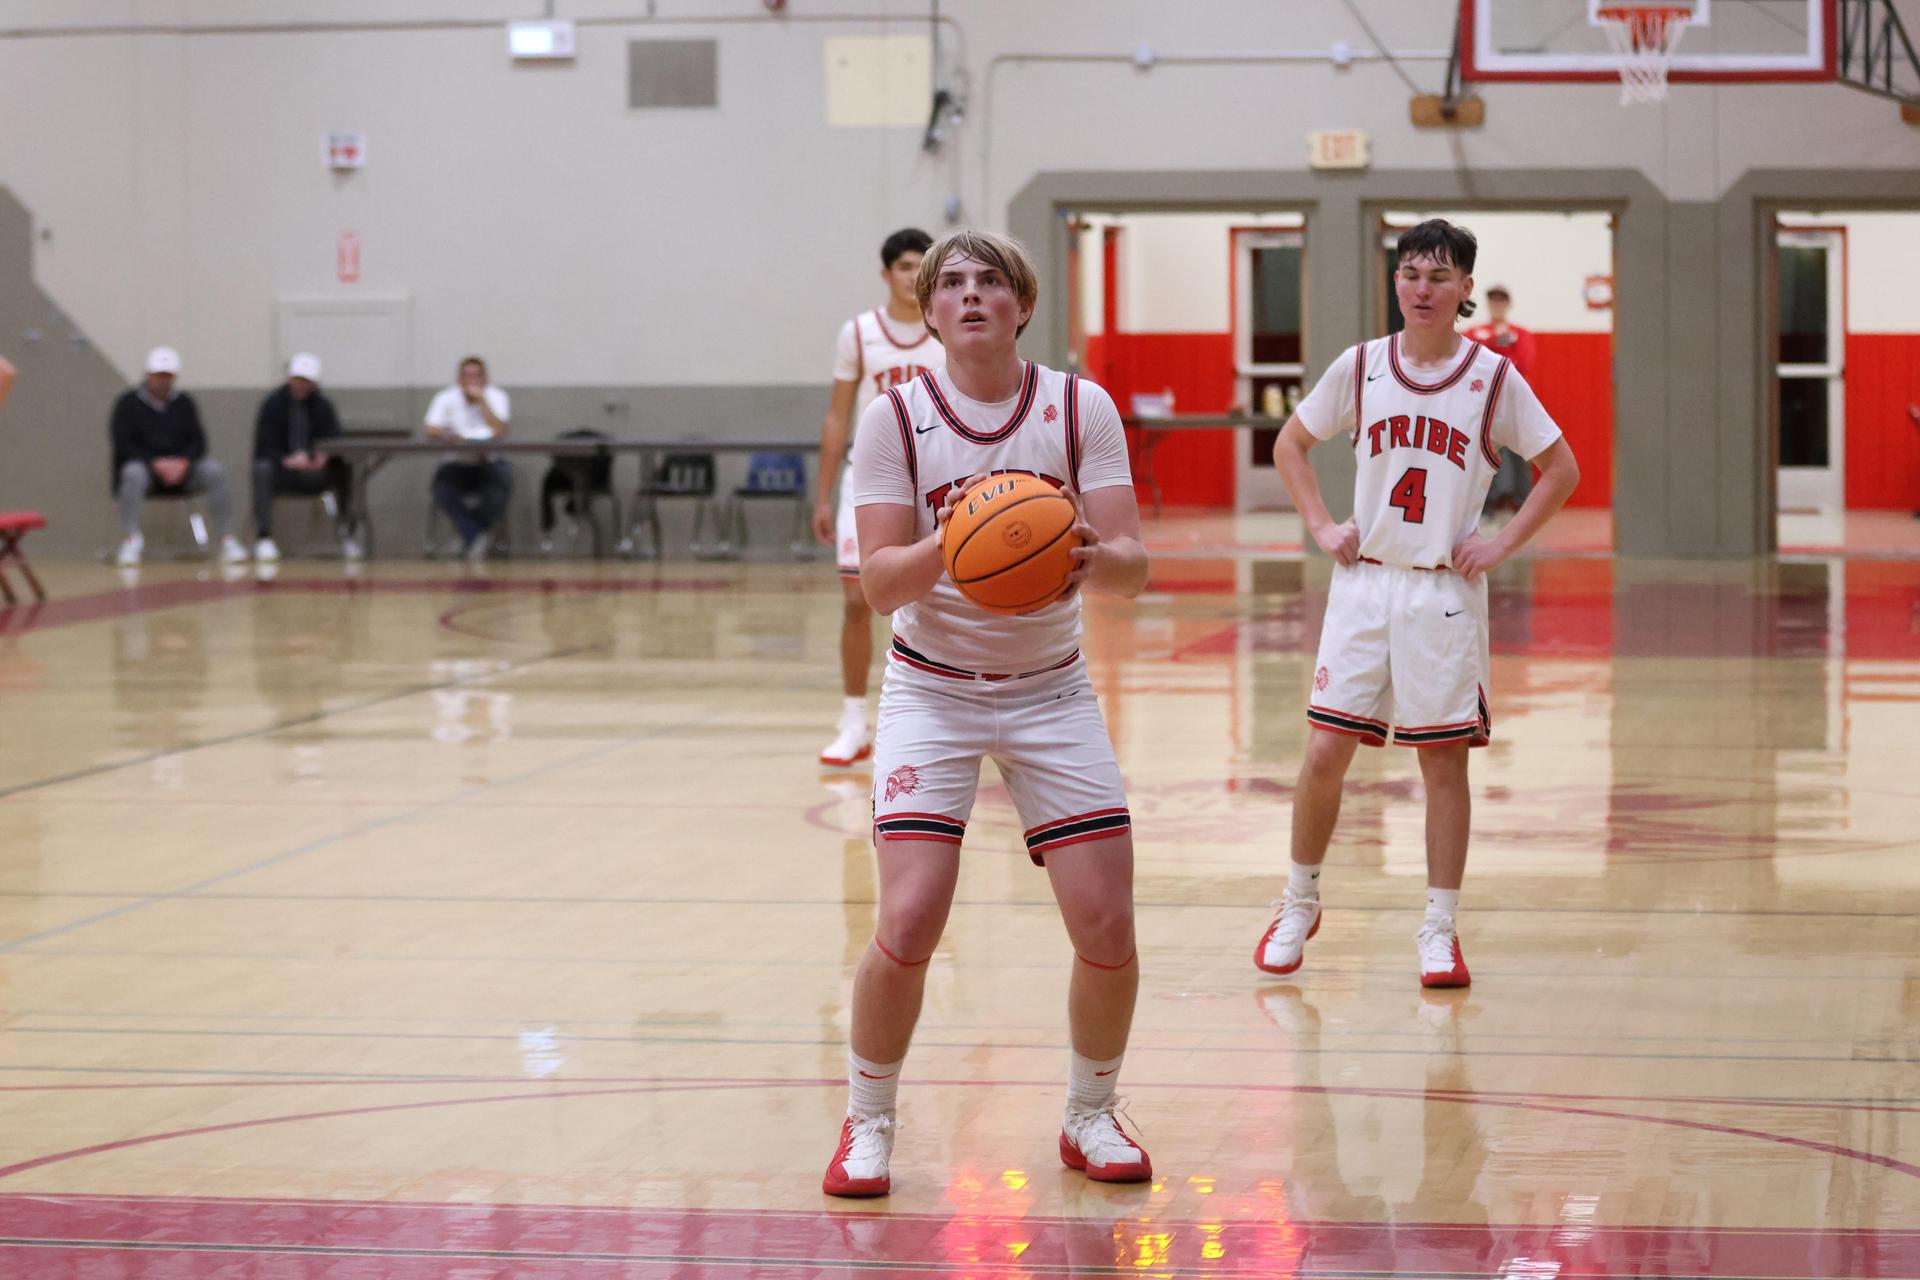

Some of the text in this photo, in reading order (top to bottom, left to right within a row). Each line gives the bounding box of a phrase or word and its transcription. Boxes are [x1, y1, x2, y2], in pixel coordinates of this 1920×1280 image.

[873, 365, 931, 394] TRI
[1368, 414, 1471, 472] TRIBE
[1389, 467, 1427, 524] 4
